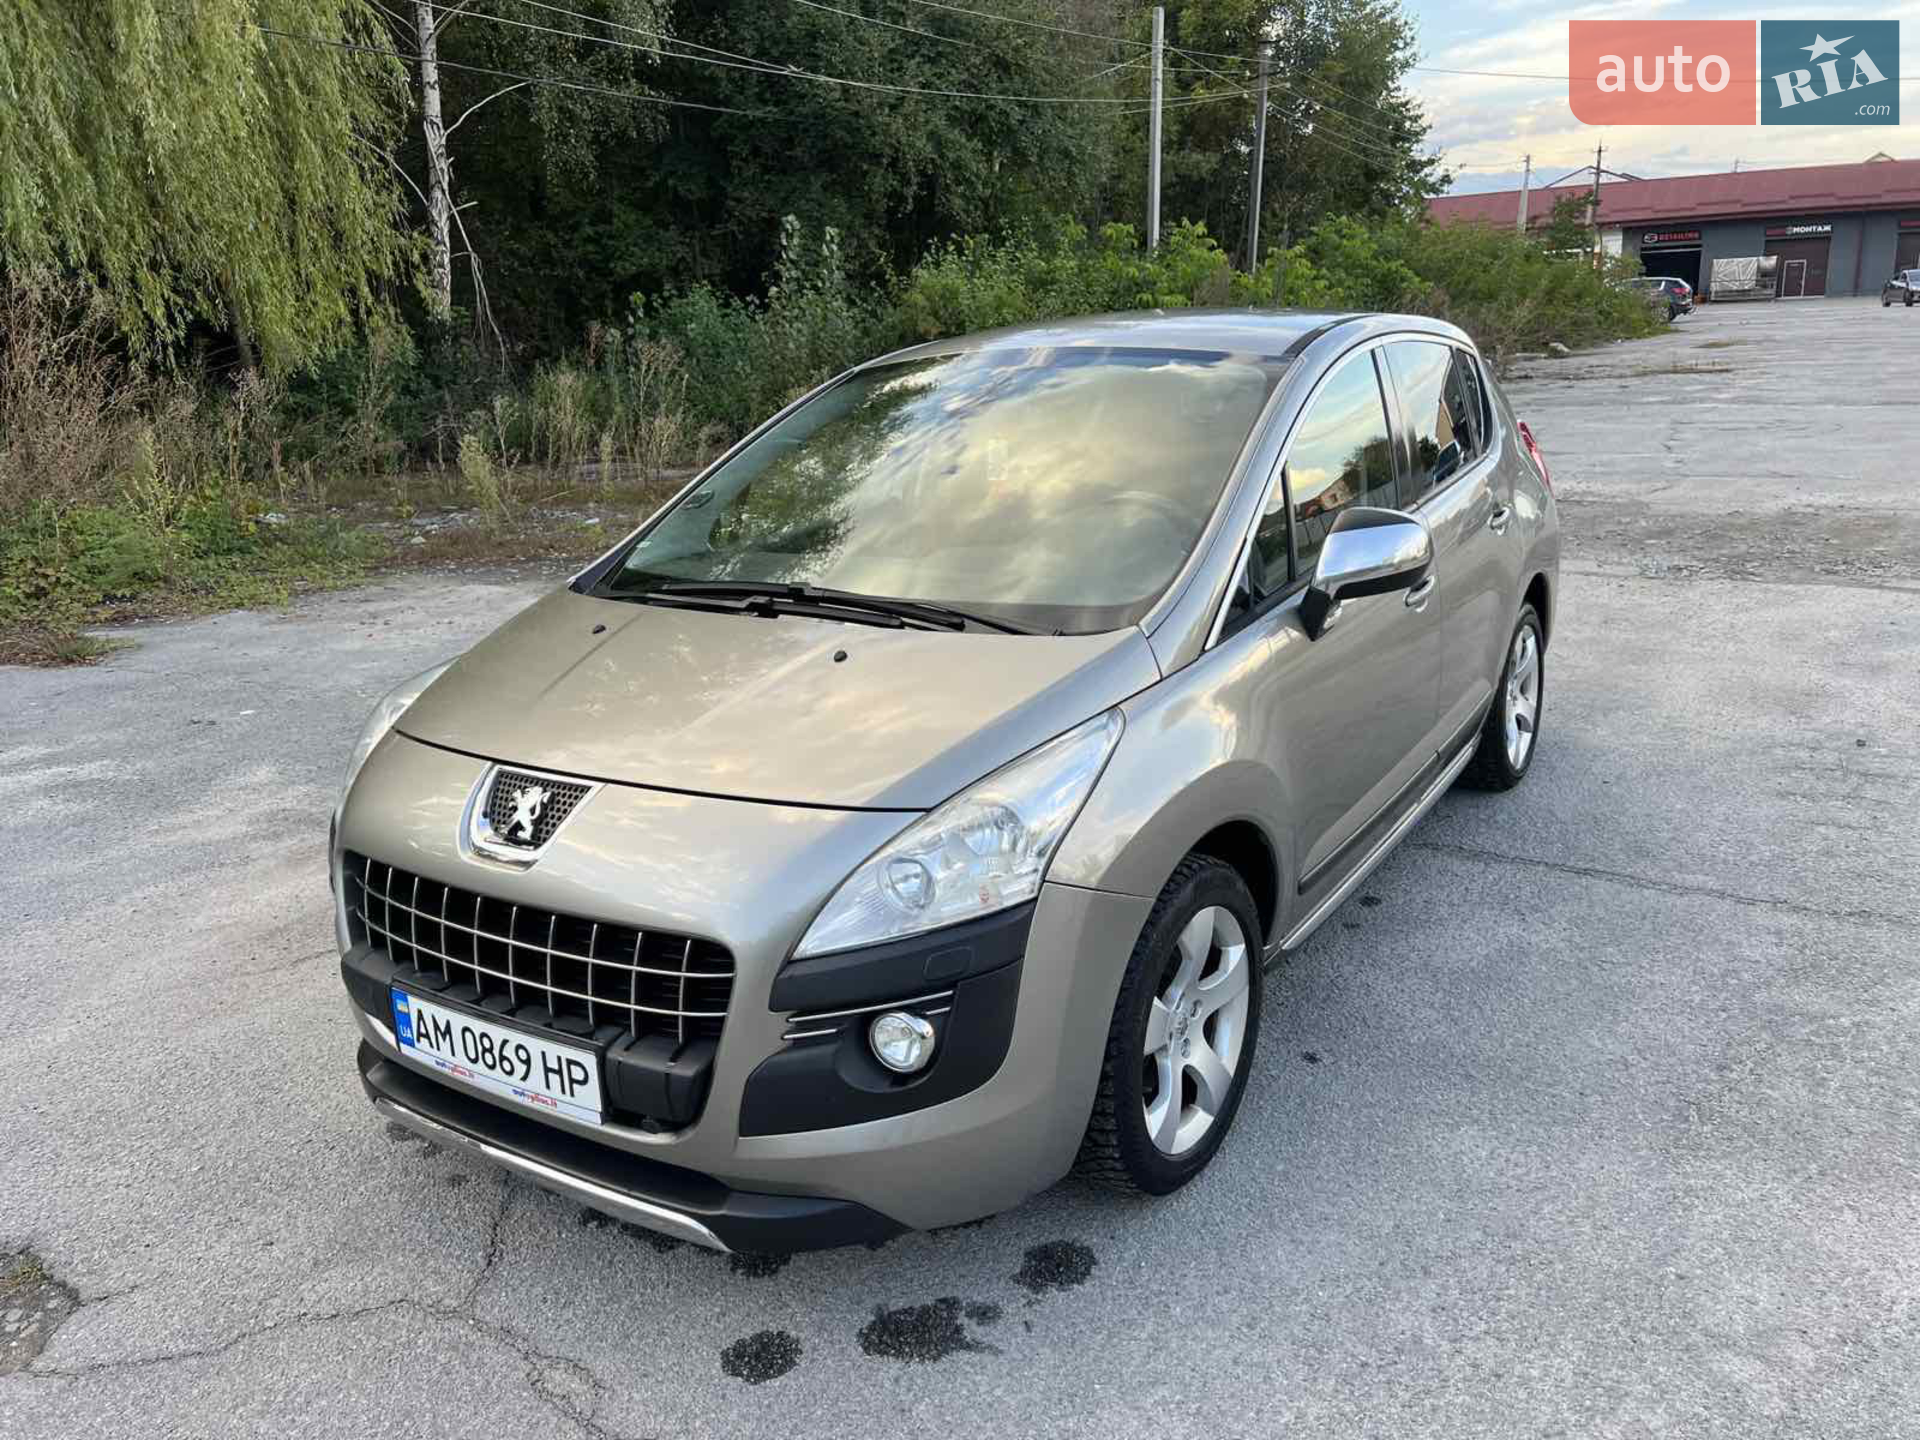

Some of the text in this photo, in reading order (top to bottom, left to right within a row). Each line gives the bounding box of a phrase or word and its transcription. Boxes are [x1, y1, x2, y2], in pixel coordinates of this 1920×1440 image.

[399, 1026, 413, 1040] UA
[416, 1008, 589, 1098] AM 0869 HP
